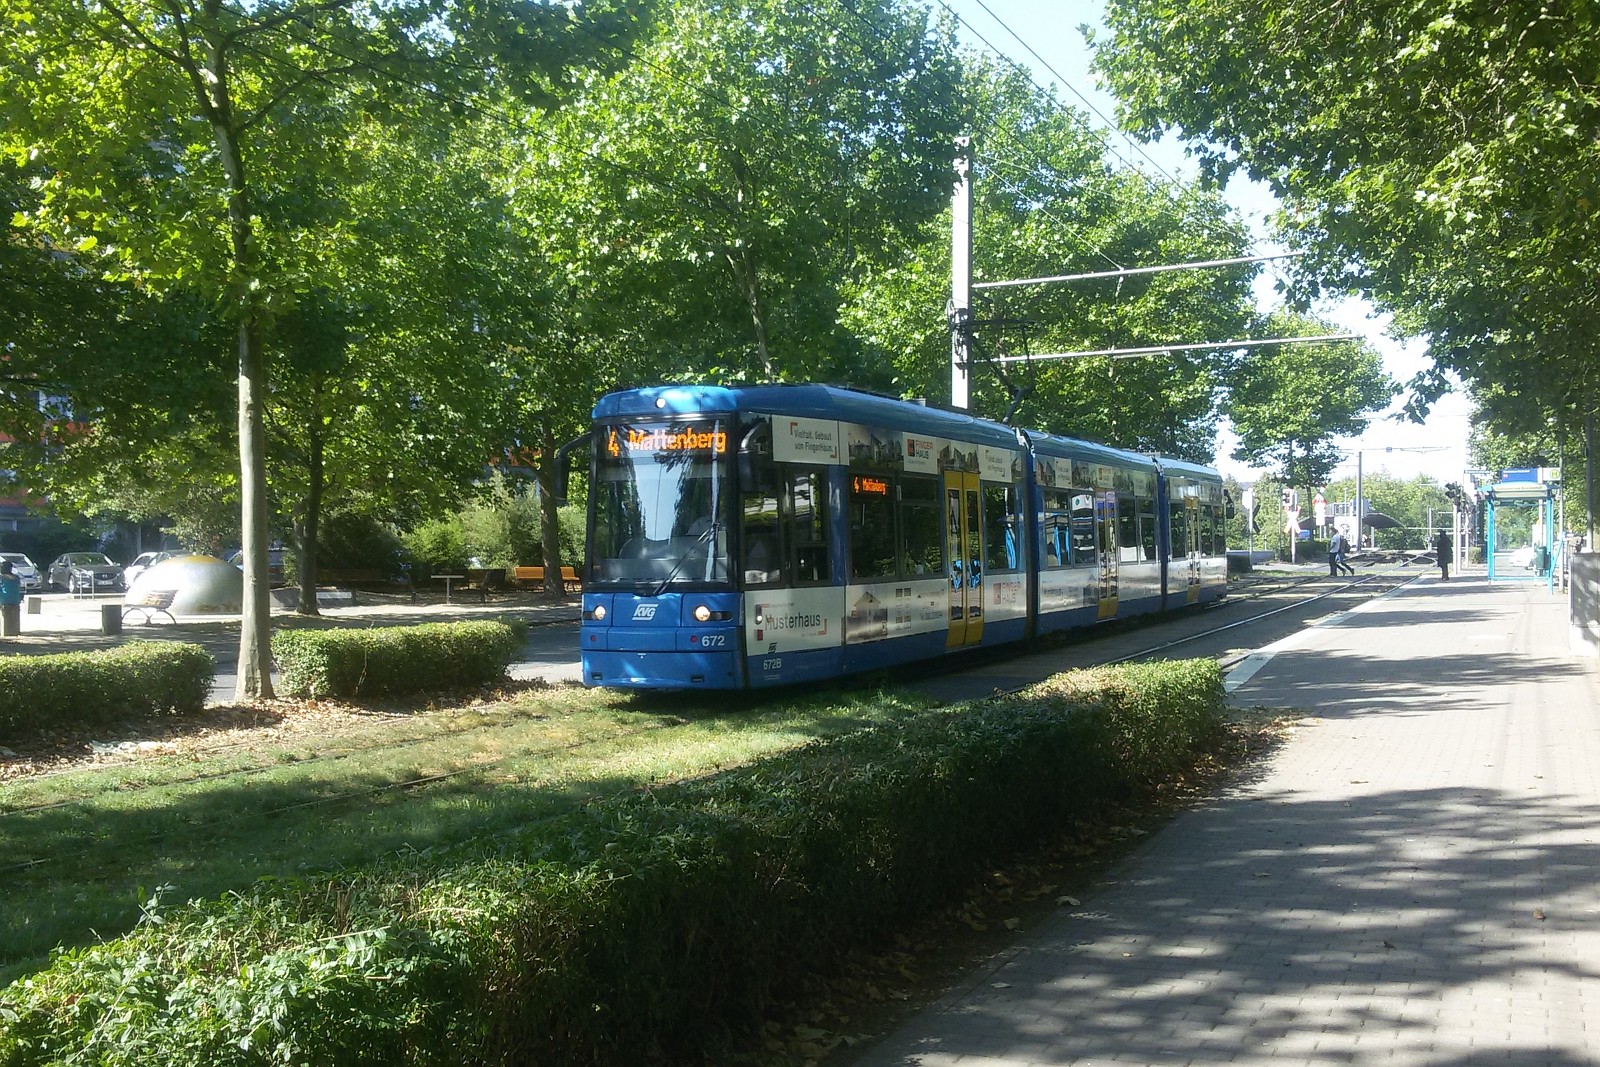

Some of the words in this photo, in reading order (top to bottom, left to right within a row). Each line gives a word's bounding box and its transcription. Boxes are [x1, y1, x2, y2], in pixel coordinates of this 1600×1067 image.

[608, 431, 620, 457] 4
[628, 427, 727, 453] Mattenberg
[632, 603, 659, 620] KVG
[764, 611, 821, 630] Musterhaus
[701, 635, 725, 647] 672
